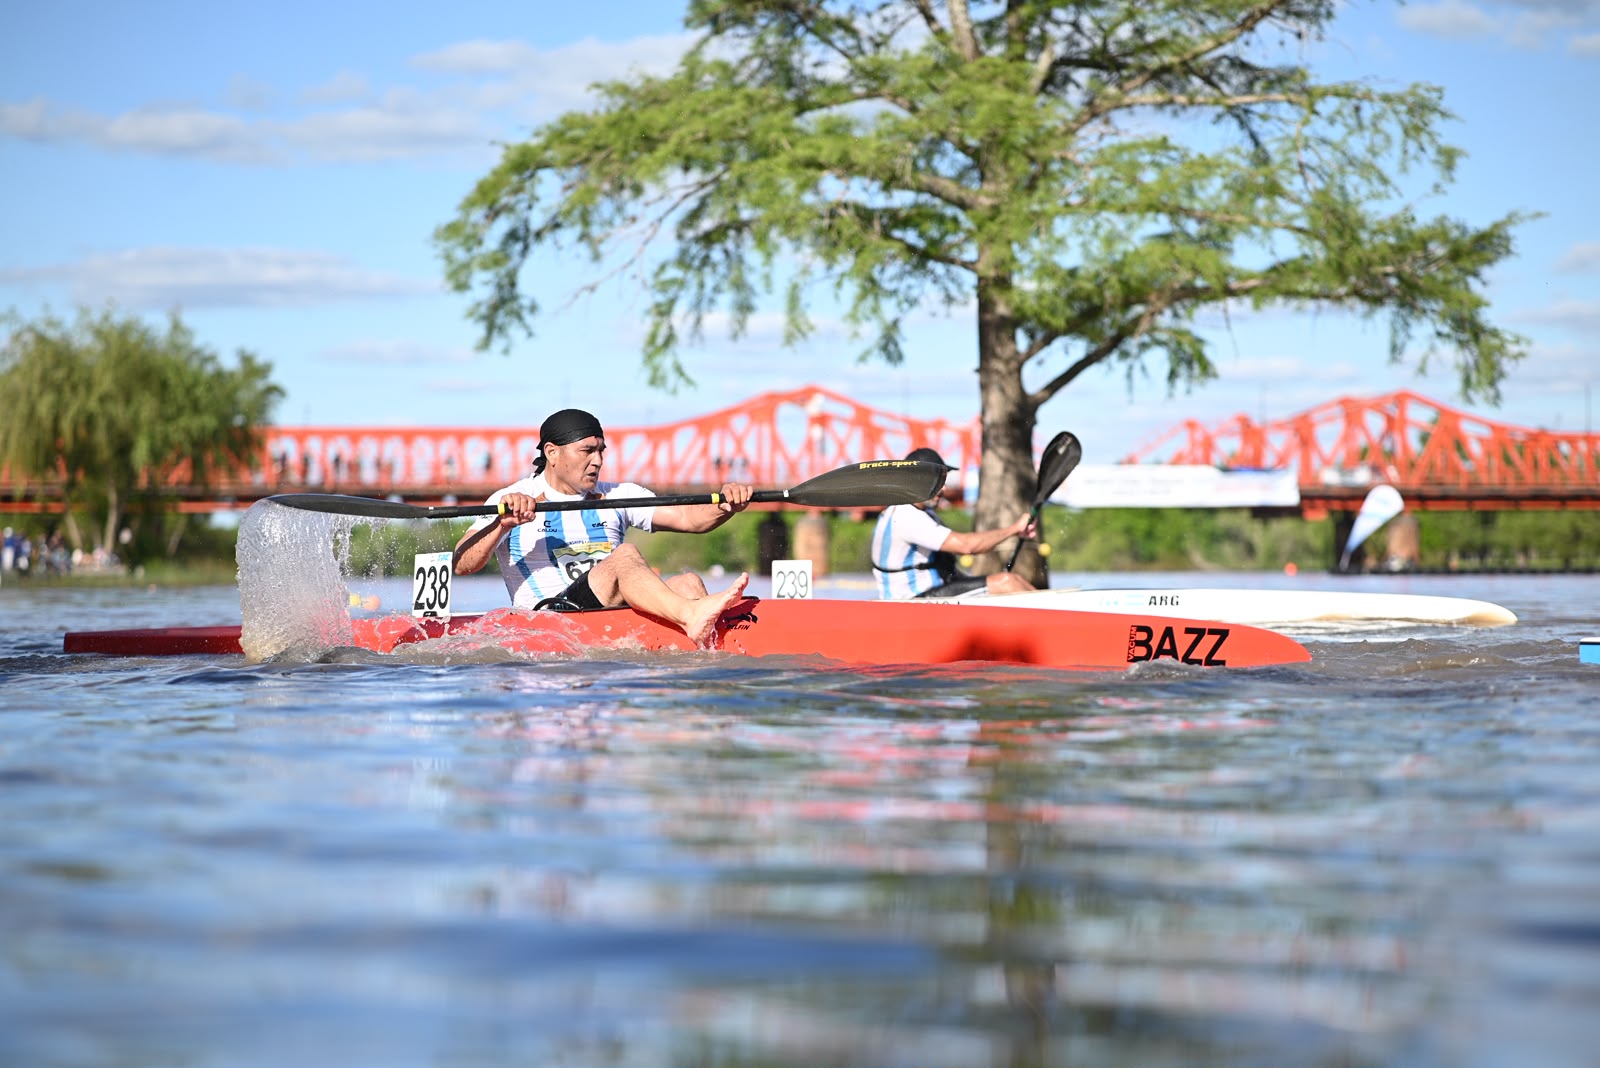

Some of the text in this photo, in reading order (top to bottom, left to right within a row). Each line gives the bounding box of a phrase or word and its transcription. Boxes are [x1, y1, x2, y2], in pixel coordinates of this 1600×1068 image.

[565, 558, 603, 581] 67
[776, 570, 809, 599] 239
[413, 564, 449, 611] 238
[1148, 595, 1180, 606] ARG
[1127, 625, 1138, 661] VACUM
[1128, 625, 1230, 667] BAZZ
